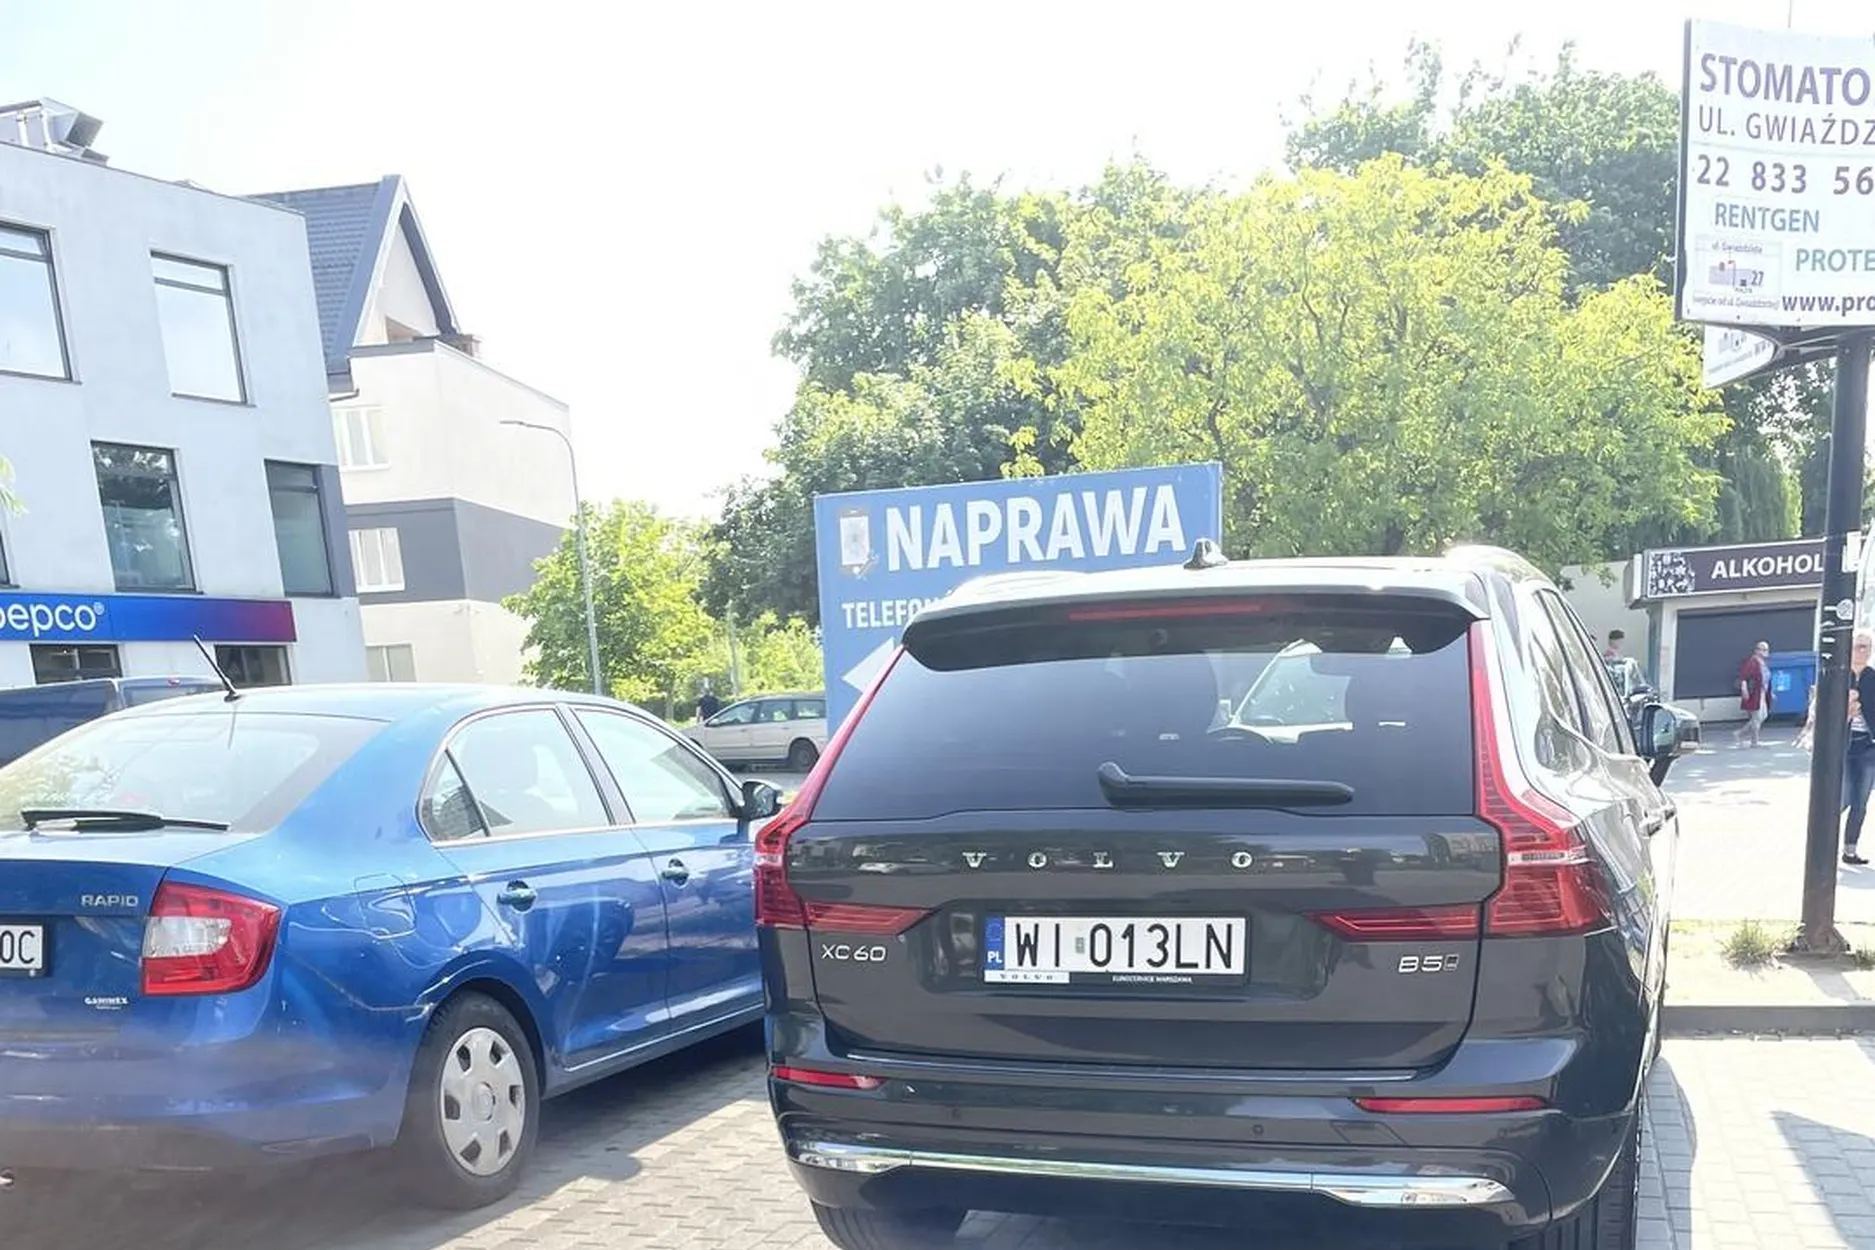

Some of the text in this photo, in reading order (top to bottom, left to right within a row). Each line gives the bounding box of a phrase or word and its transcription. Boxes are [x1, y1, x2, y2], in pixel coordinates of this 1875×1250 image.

[1700, 53, 1871, 106] STOMATO
[1699, 104, 1735, 136] UL.
[1697, 154, 1874, 195] 22 833 56
[1714, 202, 1820, 232] RENTGEN
[1795, 248, 1875, 272] PROTE
[886, 484, 1186, 572] NAPRAWA
[962, 851, 1252, 868] VOLVO
[81, 894, 139, 907] RAPID
[821, 944, 886, 961] XC60
[987, 952, 1002, 963] PL
[1015, 923, 1232, 969] WI 013LN
